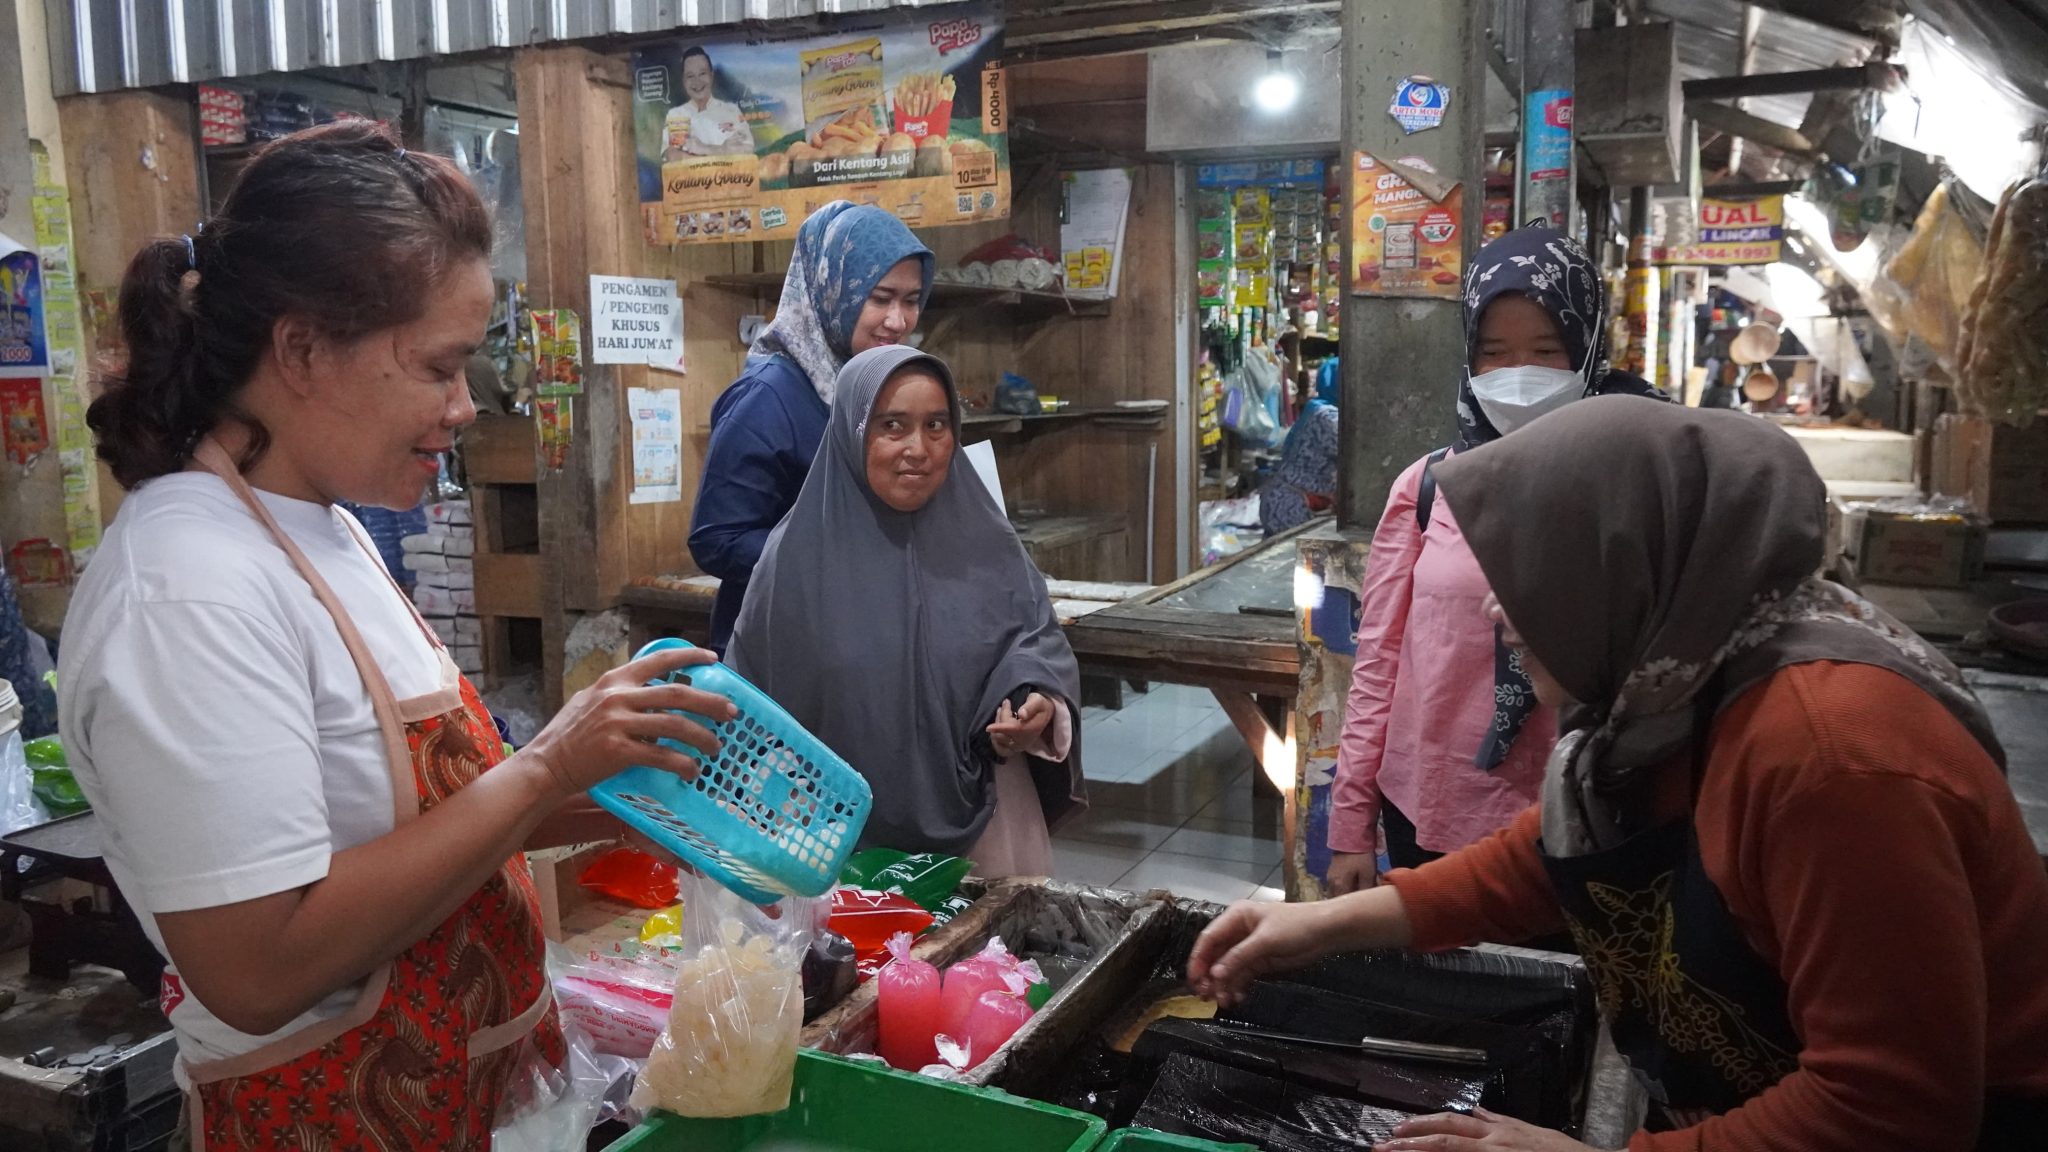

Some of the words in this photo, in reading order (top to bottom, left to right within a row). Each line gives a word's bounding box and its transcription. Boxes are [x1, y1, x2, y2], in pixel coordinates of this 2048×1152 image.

[987, 72, 999, 90] Rp
[990, 91, 1001, 127] 4000
[813, 158, 837, 173] Dari
[839, 155, 888, 170] Kentang
[889, 151, 910, 166] Asli
[667, 174, 713, 193] Kentang
[713, 170, 754, 187] Goreng
[957, 170, 970, 184] 10
[1701, 203, 1769, 225] UAL
[601, 282, 668, 297] PENGAMEN
[609, 301, 669, 315] PENGEMIS
[612, 319, 660, 332] KHUSUS
[598, 337, 629, 349] HARI
[631, 337, 674, 350] JUM'AT
